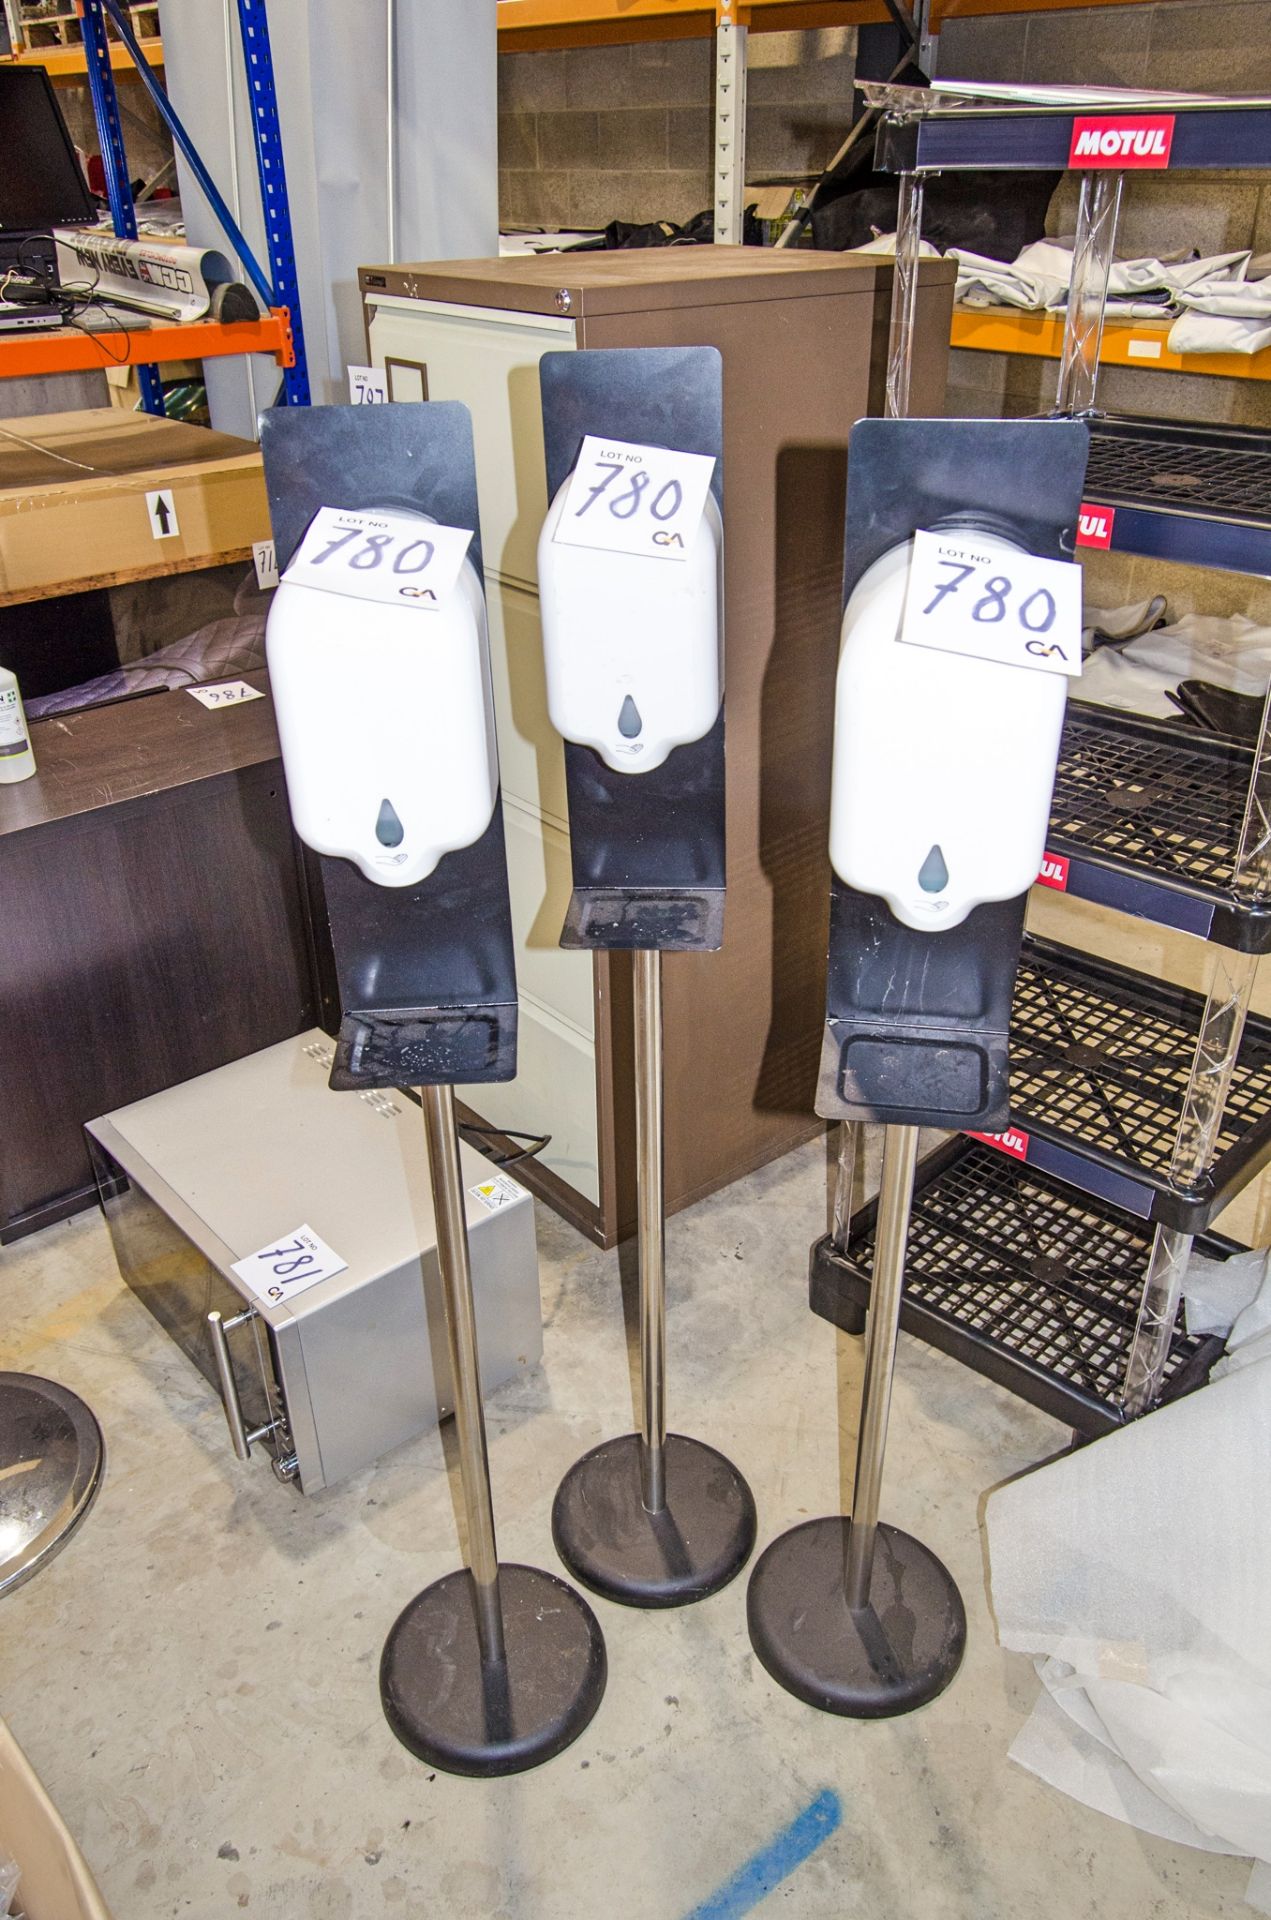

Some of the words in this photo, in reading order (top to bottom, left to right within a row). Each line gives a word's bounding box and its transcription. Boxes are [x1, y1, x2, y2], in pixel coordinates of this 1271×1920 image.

[1074, 130, 1166, 156] MOTUL
[100, 252, 139, 281] EVERY
[139, 260, 194, 294] CCM
[600, 450, 623, 460] LOT
[625, 454, 642, 463] NO
[575, 462, 683, 521] 780
[339, 516, 365, 525] LOT
[1079, 514, 1107, 538] UL
[258, 550, 279, 573] 71
[310, 525, 435, 574] 780
[939, 547, 965, 559] LOT
[970, 555, 991, 564] NO
[923, 560, 1056, 633] 780
[209, 688, 253, 702] 786
[300, 1235, 311, 1245] LOT
[308, 1242, 318, 1251] NO
[257, 1239, 323, 1284] 781
